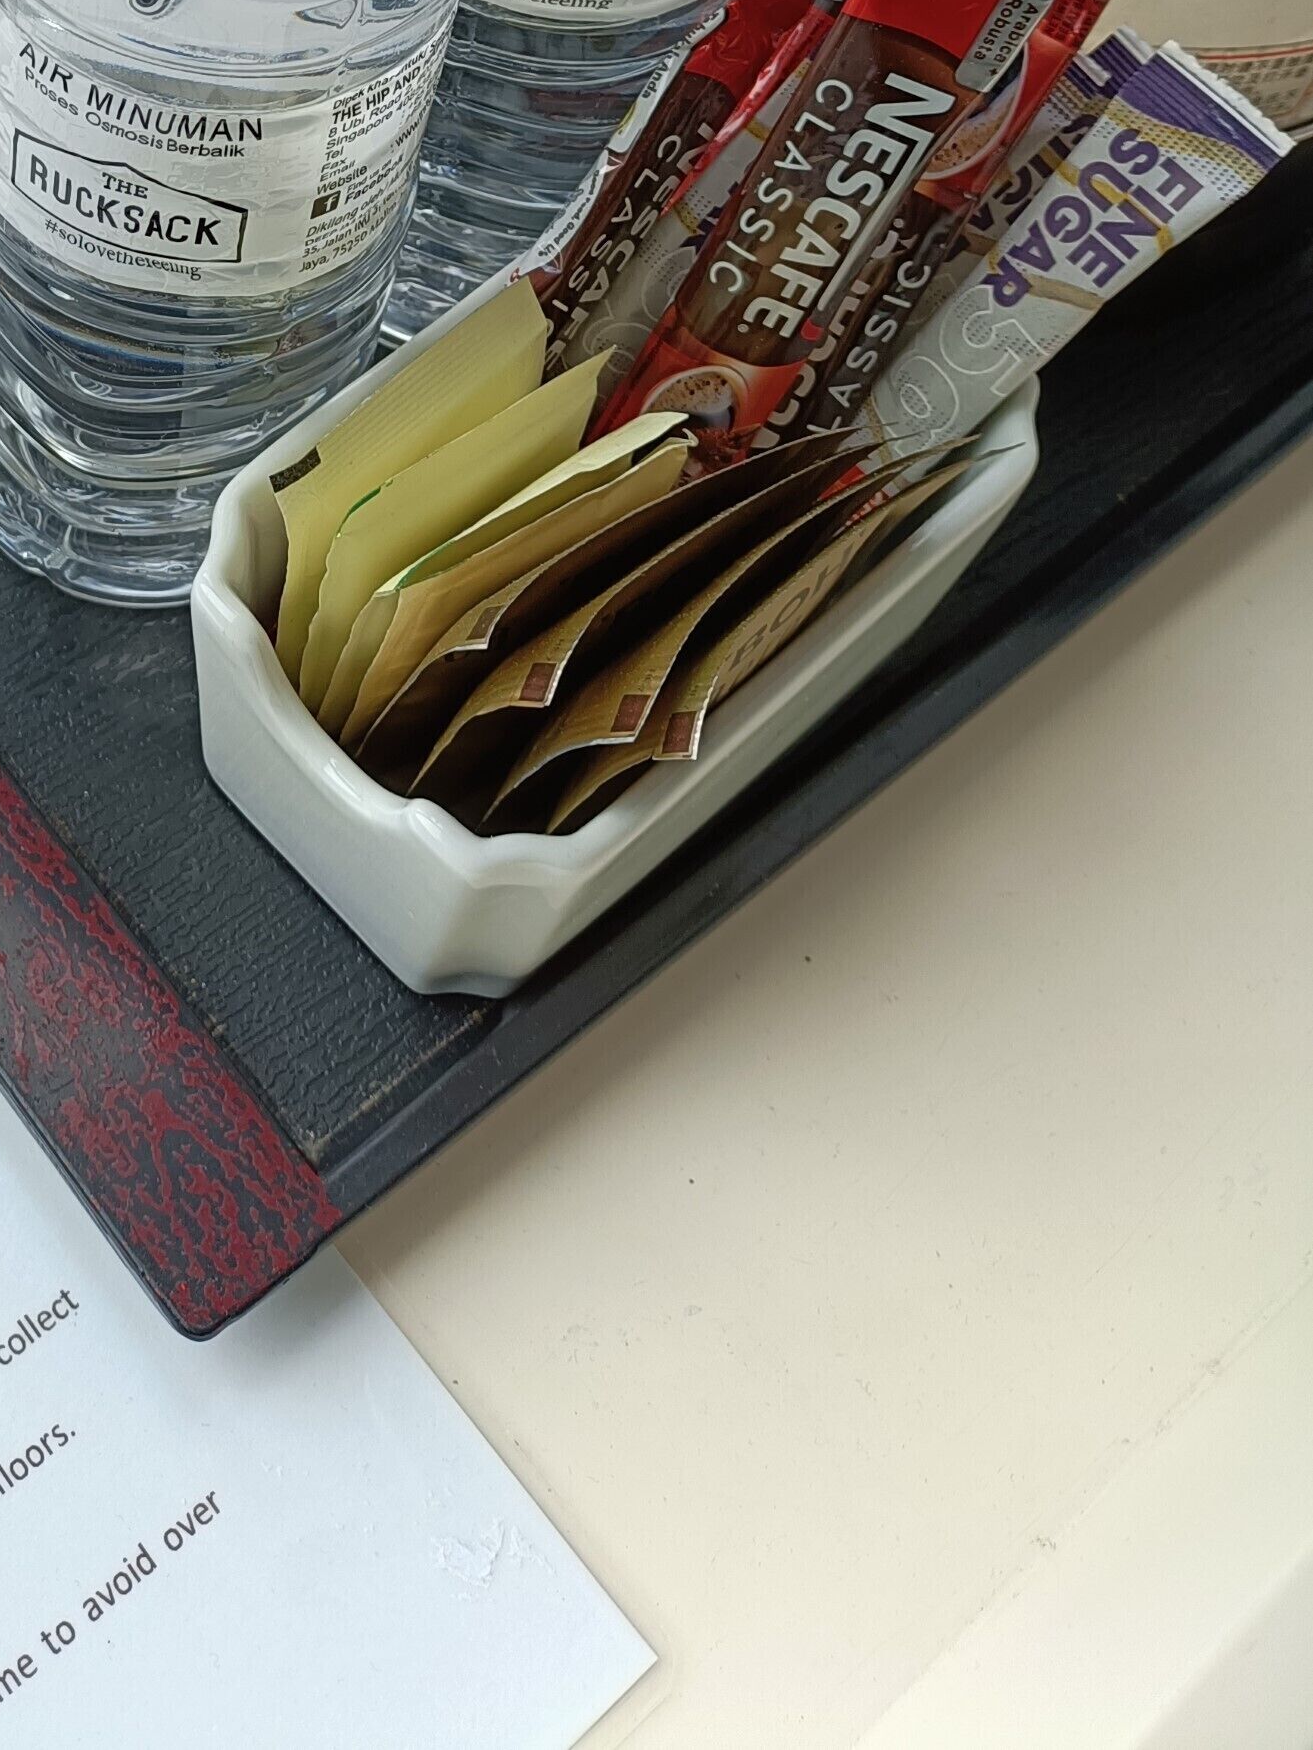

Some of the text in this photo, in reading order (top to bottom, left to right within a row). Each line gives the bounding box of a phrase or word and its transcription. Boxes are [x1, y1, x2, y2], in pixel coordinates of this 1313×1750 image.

[993, 2, 1039, 64] Arabica
[19, 42, 263, 142] AIR MINUMAN
[25, 66, 246, 158] Proses Osmosis Berbalik
[326, 109, 393, 150] Singapore
[332, 107, 362, 125] THE
[366, 87, 390, 111] HIP
[30, 154, 222, 246] RUCKSACK
[101, 171, 148, 200] THE
[317, 165, 368, 195] Website
[321, 157, 348, 174] Fax
[344, 153, 404, 205] Facebook
[709, 78, 854, 294] CLASSIC
[981, 128, 1160, 308] SUGAR
[1065, 156, 1205, 289] FINE
[298, 255, 330, 273] Jaya,
[806, 260, 931, 435] LASSIC
[39, 1620, 77, 1656] to
[82, 1541, 158, 1623] avoid
[162, 1490, 221, 1553] over
